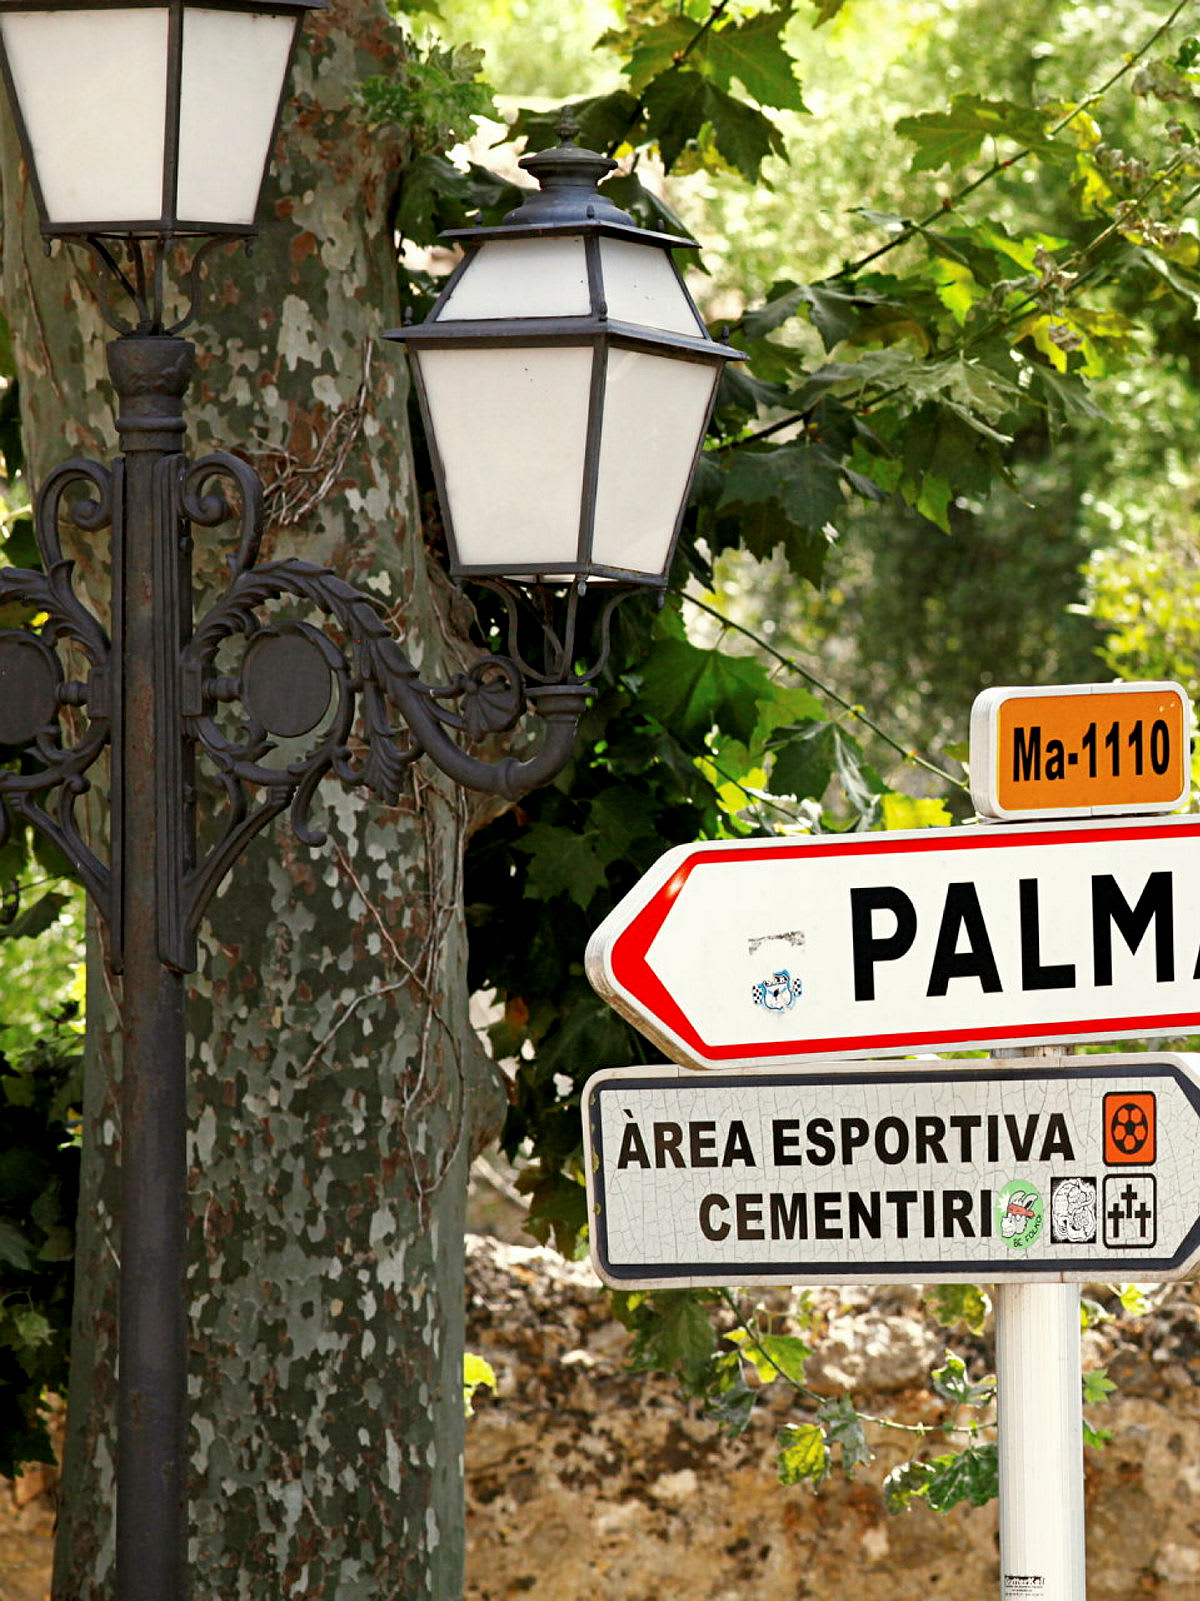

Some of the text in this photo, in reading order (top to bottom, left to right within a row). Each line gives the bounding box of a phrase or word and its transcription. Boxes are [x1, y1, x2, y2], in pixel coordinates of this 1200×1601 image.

[1013, 719, 1170, 782] Ma-1110
[617, 1108, 1076, 1170] ÀREA ESPORTIVA
[699, 1189, 992, 1242] CEMENTIRI
